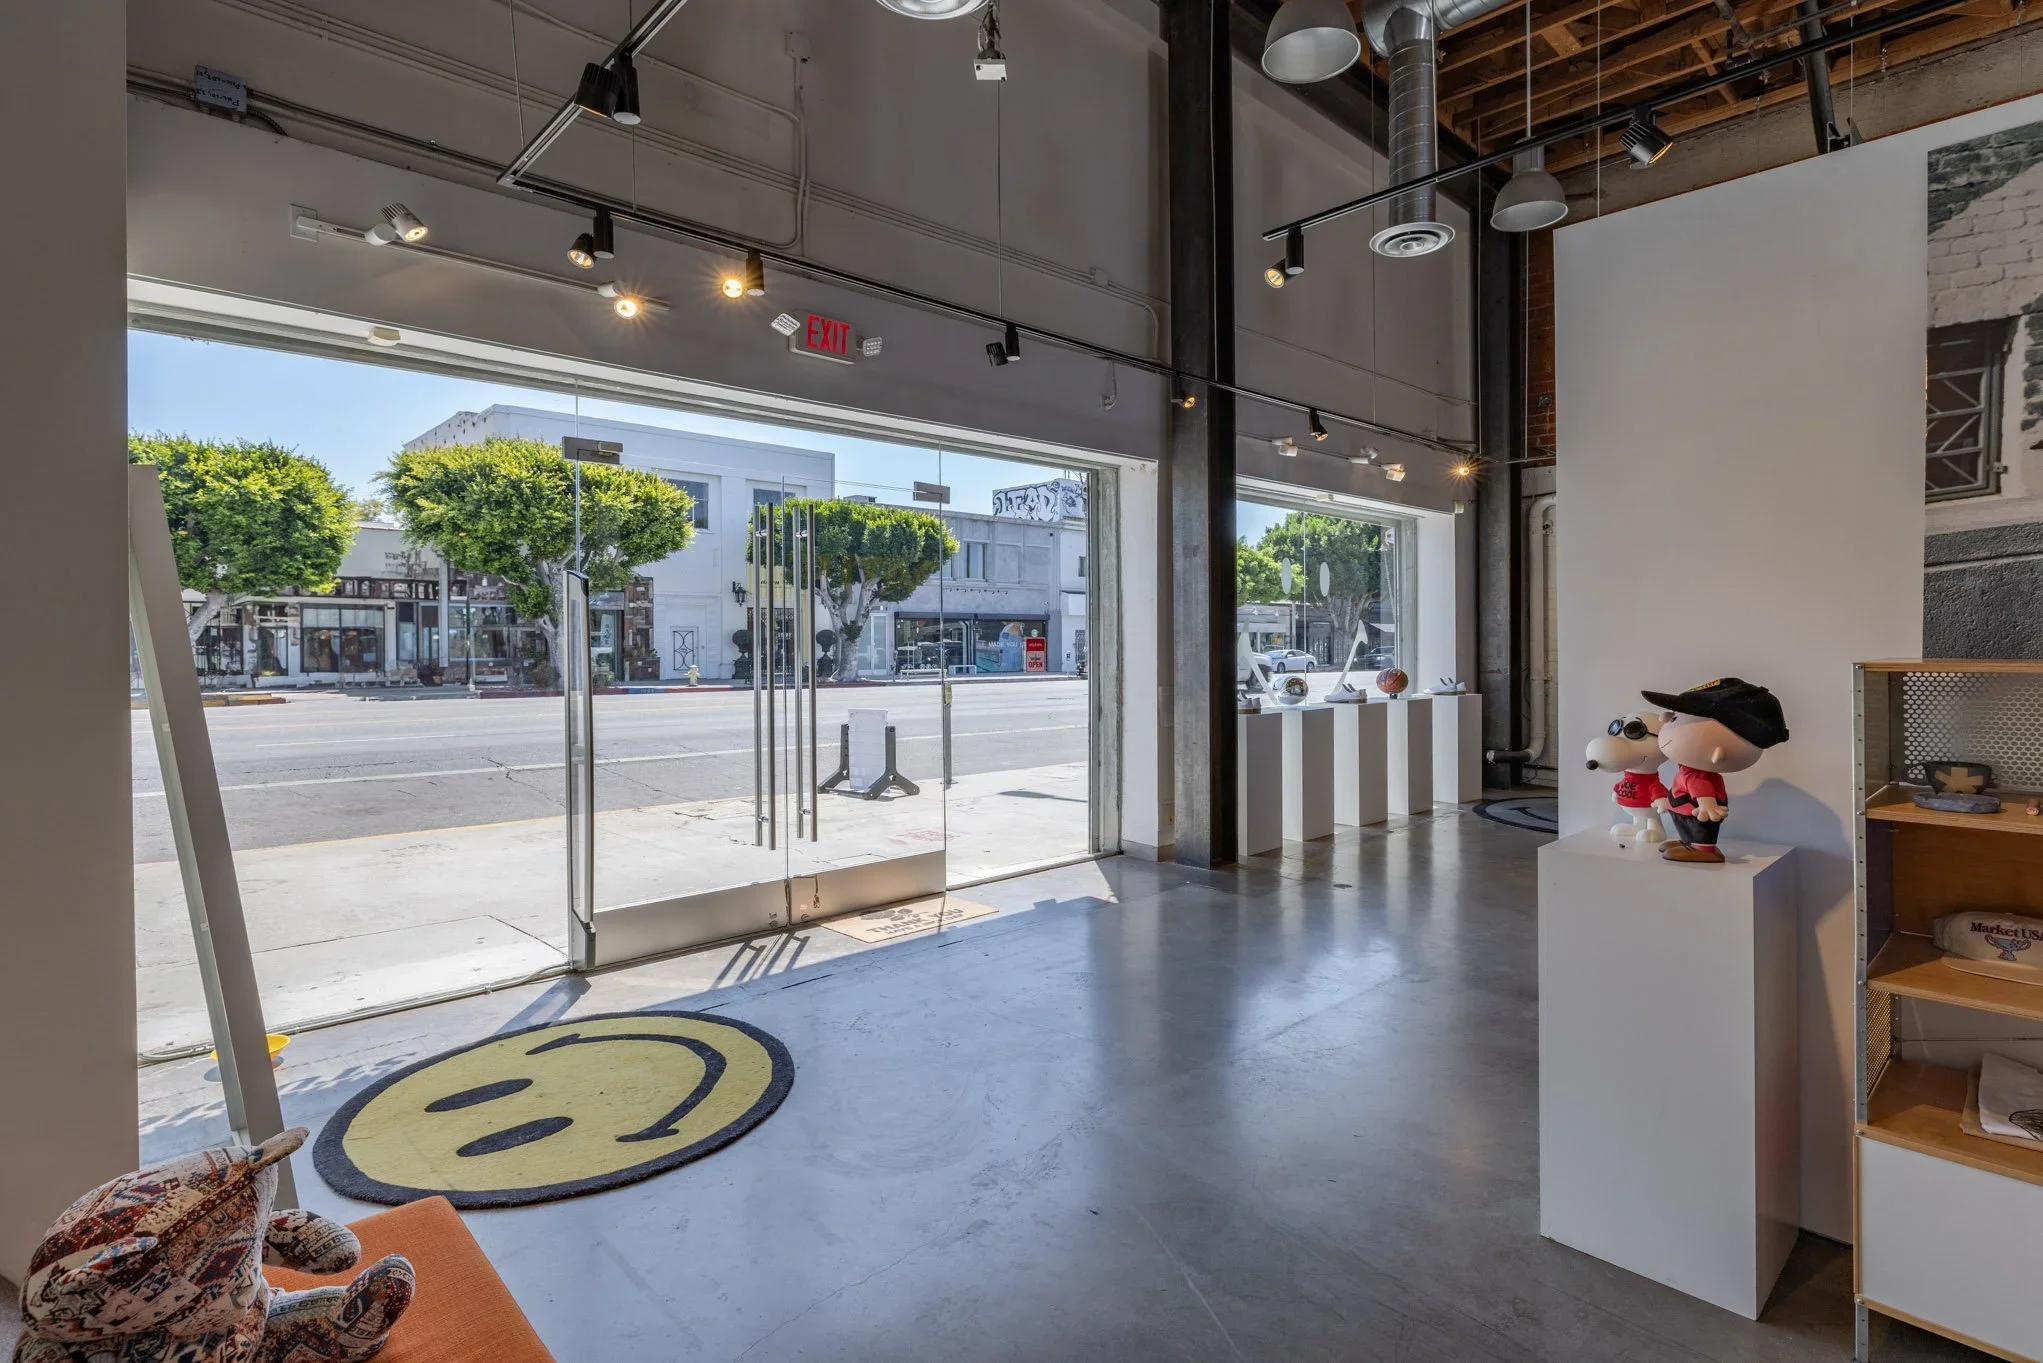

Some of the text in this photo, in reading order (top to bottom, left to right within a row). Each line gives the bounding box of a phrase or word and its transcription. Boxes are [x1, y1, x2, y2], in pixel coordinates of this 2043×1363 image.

[806, 313, 850, 355] EXIT
[1621, 781, 1637, 790] JOE
[1618, 789, 1638, 800] COOL
[866, 908, 964, 933] THANK YOU
[1969, 922, 2020, 938] Market
